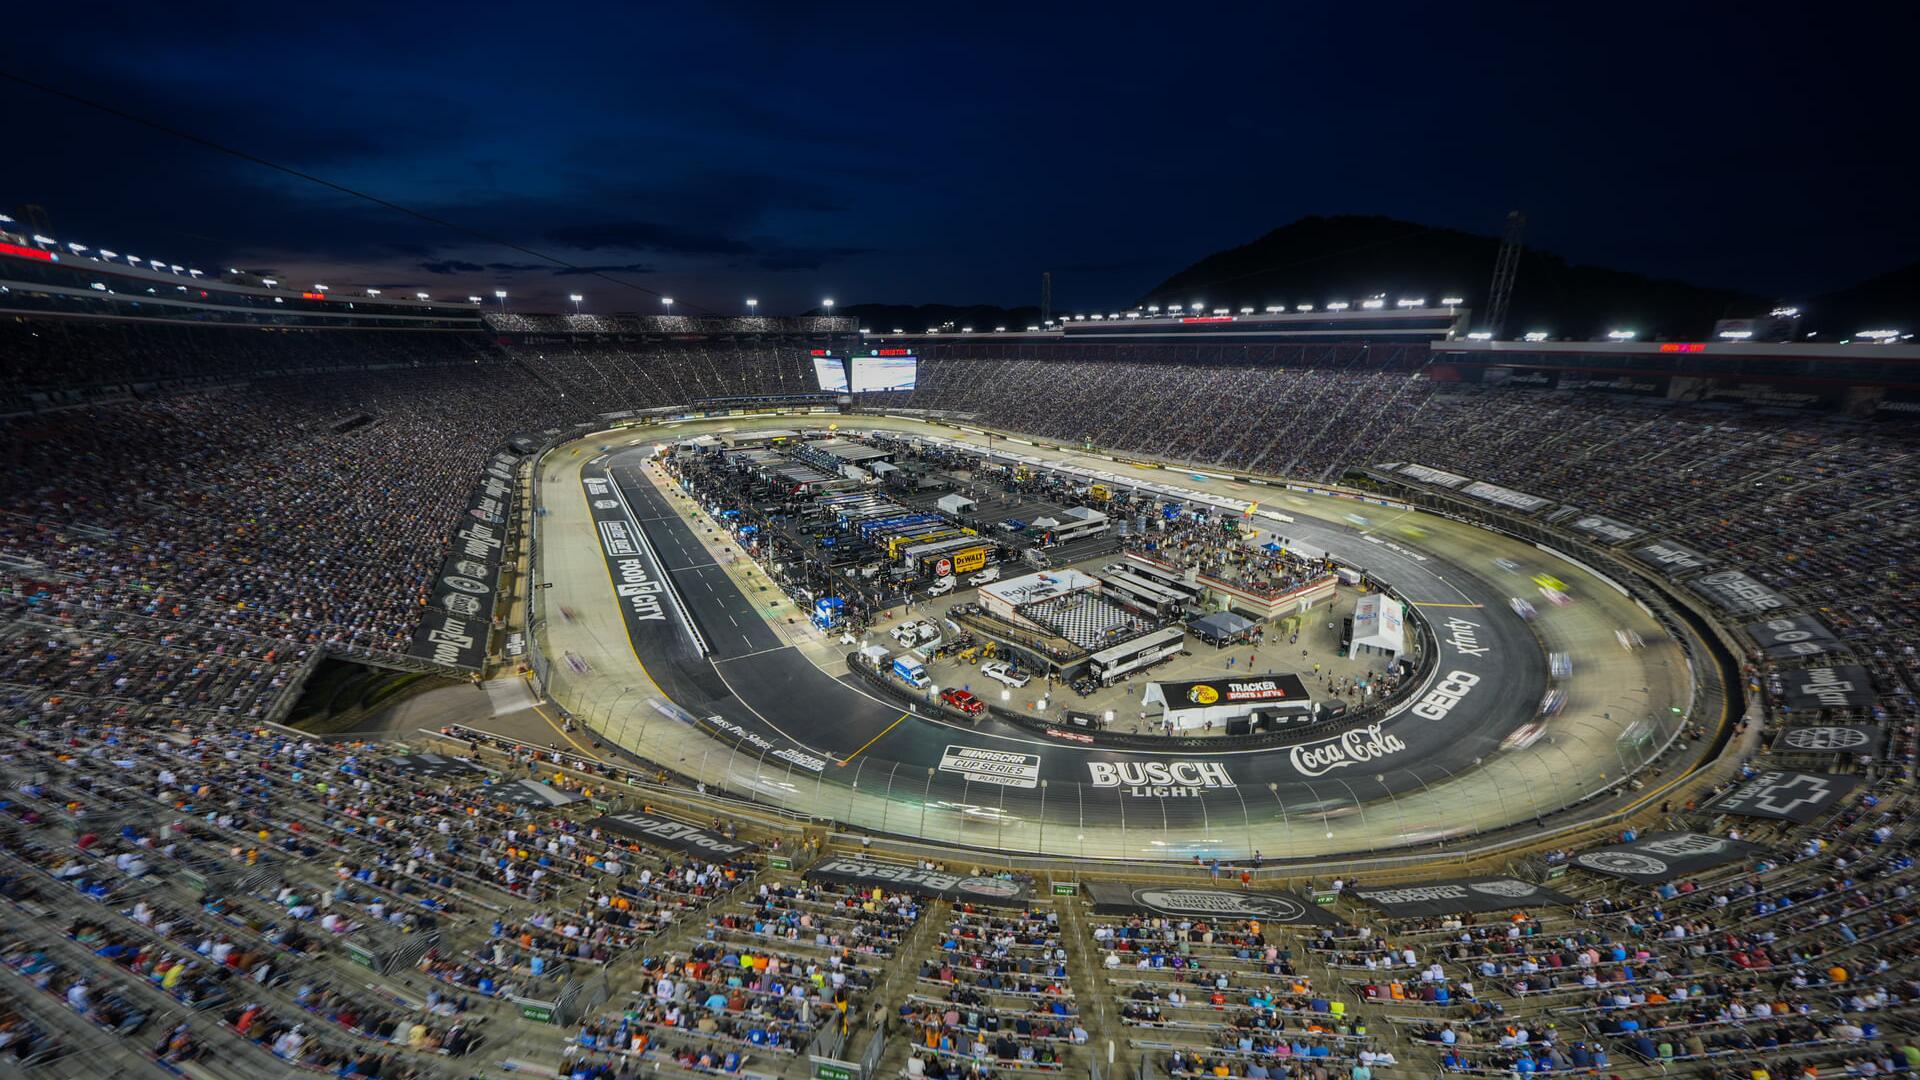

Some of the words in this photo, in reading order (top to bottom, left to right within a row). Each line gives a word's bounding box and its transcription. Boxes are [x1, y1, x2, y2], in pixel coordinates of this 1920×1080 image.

[617, 558, 648, 583] FOOD
[631, 594, 667, 620] CITY
[442, 617, 467, 636] CITY
[1443, 616, 1490, 657] xfinity
[432, 643, 460, 668] FOOD
[1228, 681, 1277, 692] TRACKER
[1411, 670, 1480, 720] GEICO
[707, 715, 733, 729] Bass
[972, 750, 1027, 764] NASCAR
[954, 760, 979, 771] CUP
[982, 763, 1025, 775] SERIES
[1087, 761, 1237, 788] BUSCH
[978, 775, 1022, 786] PLAYOFFS
[1131, 786, 1201, 797] LIGHT
[609, 813, 662, 828] CITY
[683, 833, 745, 853] FOOD
[818, 861, 957, 891] Bristol
[1375, 889, 1469, 904] TRACKER
[1166, 902, 1241, 912] SPEEDWAY
